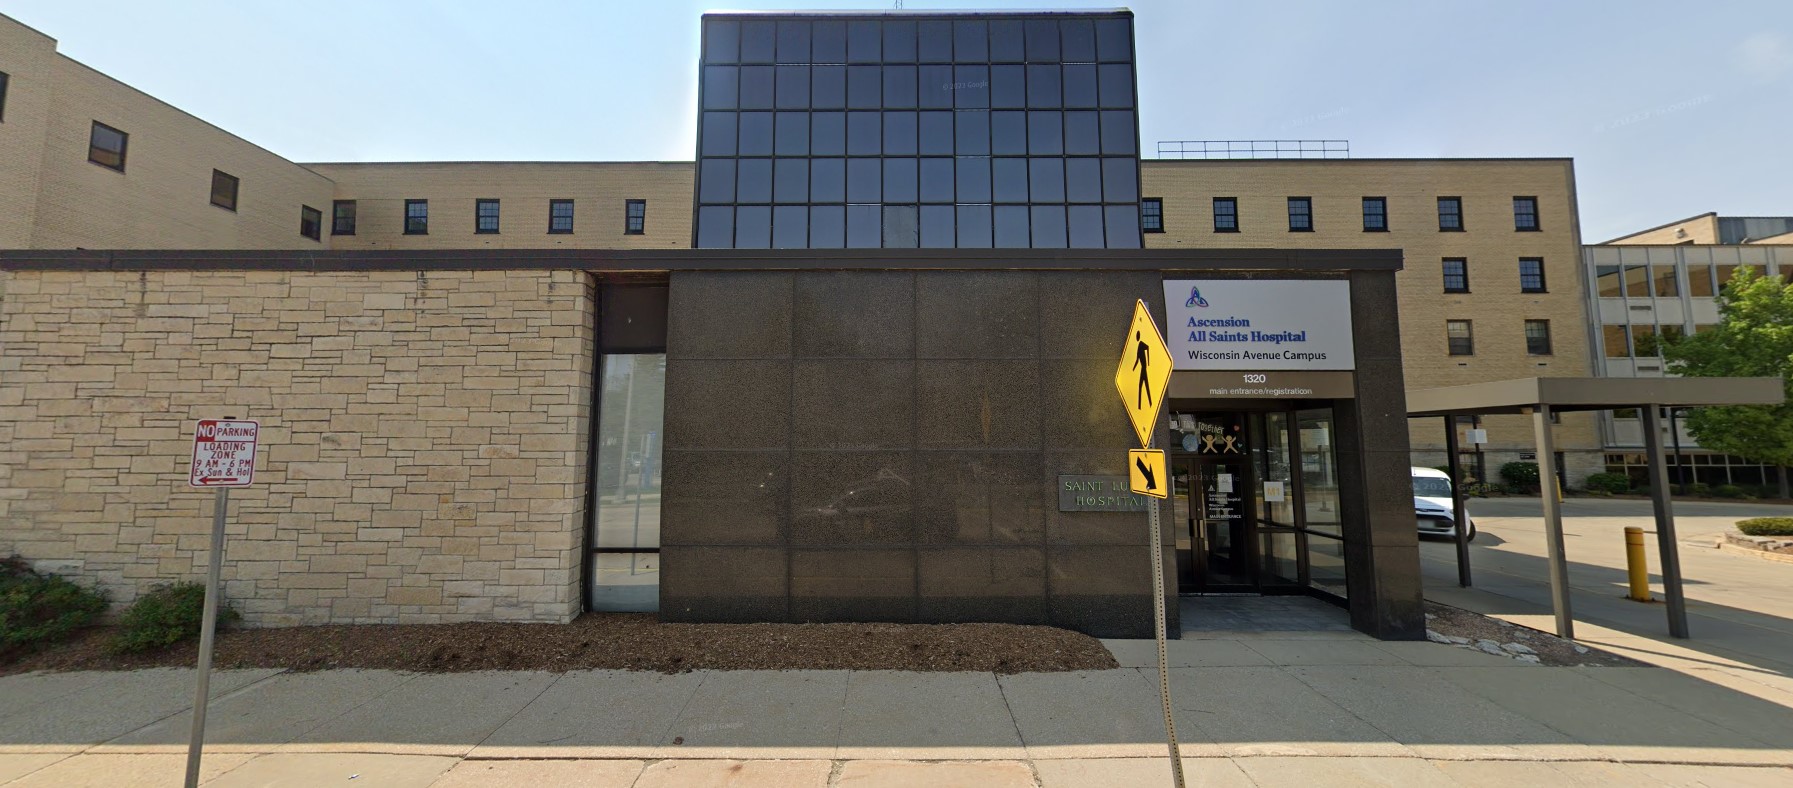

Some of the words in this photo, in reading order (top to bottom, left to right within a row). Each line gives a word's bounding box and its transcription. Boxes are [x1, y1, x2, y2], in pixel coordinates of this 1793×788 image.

[1187, 316, 1250, 328] Ascension
[1188, 331, 1206, 342] All
[1209, 331, 1249, 342] Saints
[1250, 331, 1306, 345] Hospital
[1188, 350, 1240, 360] Wisconsin
[1243, 350, 1281, 360] Avenue
[1283, 350, 1327, 362] Campus
[1243, 374, 1266, 384] 1320
[197, 424, 215, 438] NO
[216, 427, 255, 437] PARKING
[203, 442, 246, 451] LOADING
[210, 451, 236, 460] ZONE
[195, 459, 202, 468] 9
[205, 459, 219, 468] AM
[229, 459, 235, 468] 6
[239, 459, 251, 468] PM
[194, 468, 204, 477] Ex
[207, 468, 222, 477] Sun
[225, 468, 233, 477] &
[236, 467, 250, 476] Hol
[1065, 481, 1103, 491] SAINT
